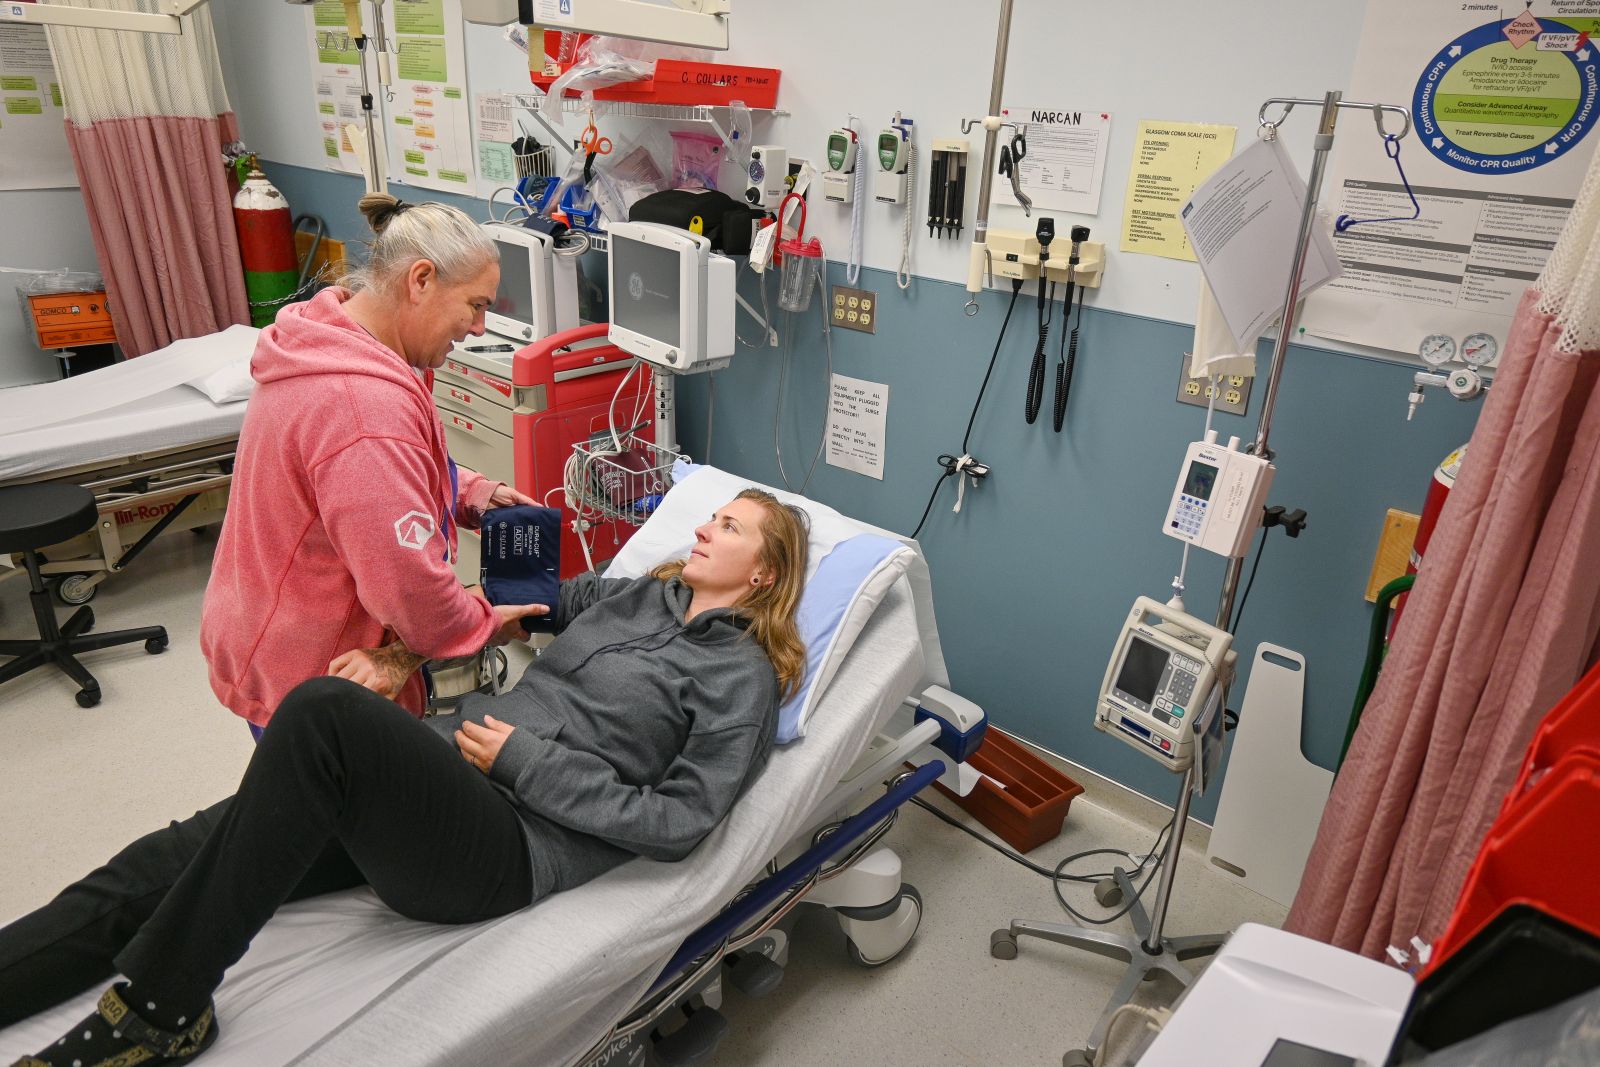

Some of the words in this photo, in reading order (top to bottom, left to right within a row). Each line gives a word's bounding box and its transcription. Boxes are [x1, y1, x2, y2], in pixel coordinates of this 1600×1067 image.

[696, 73, 738, 86] COLLARS
[1420, 82, 1434, 134] Continuous
[1429, 61, 1447, 81] CPR
[1578, 64, 1596, 122] Continuous
[1032, 111, 1081, 125] NARCAN
[1515, 111, 1559, 119] capnography
[1561, 123, 1582, 143] CPR
[1446, 148, 1479, 166] Monitor
[1480, 159, 1500, 168] CPR
[1502, 155, 1536, 168] Quality
[834, 392, 856, 402] EQUIPMENT
[859, 398, 879, 406] PLUGGED
[832, 433, 850, 441] DIRECTLY
[1198, 453, 1217, 462] Baxter
